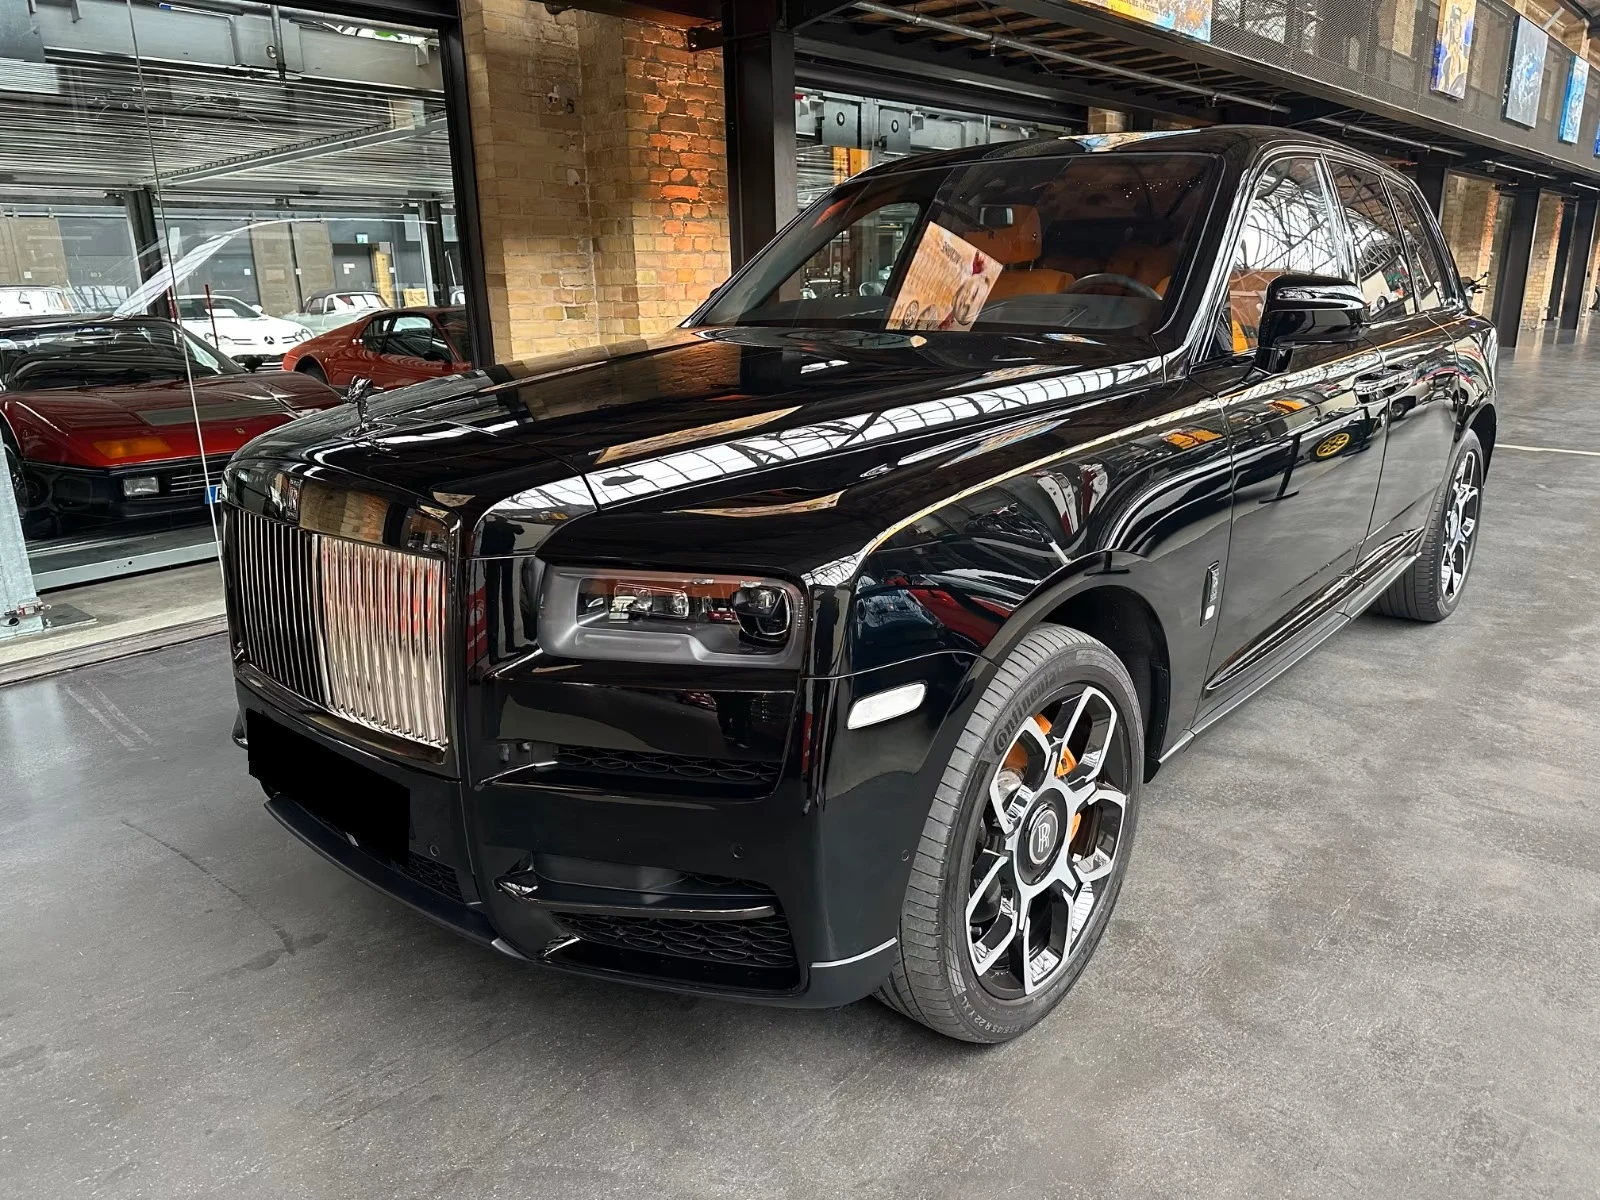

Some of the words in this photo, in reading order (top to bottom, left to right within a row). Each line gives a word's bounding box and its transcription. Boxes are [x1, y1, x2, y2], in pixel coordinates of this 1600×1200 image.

[993, 667, 1059, 756] Continenta
[974, 1014, 986, 1027] 22
[984, 1022, 992, 1031] R
